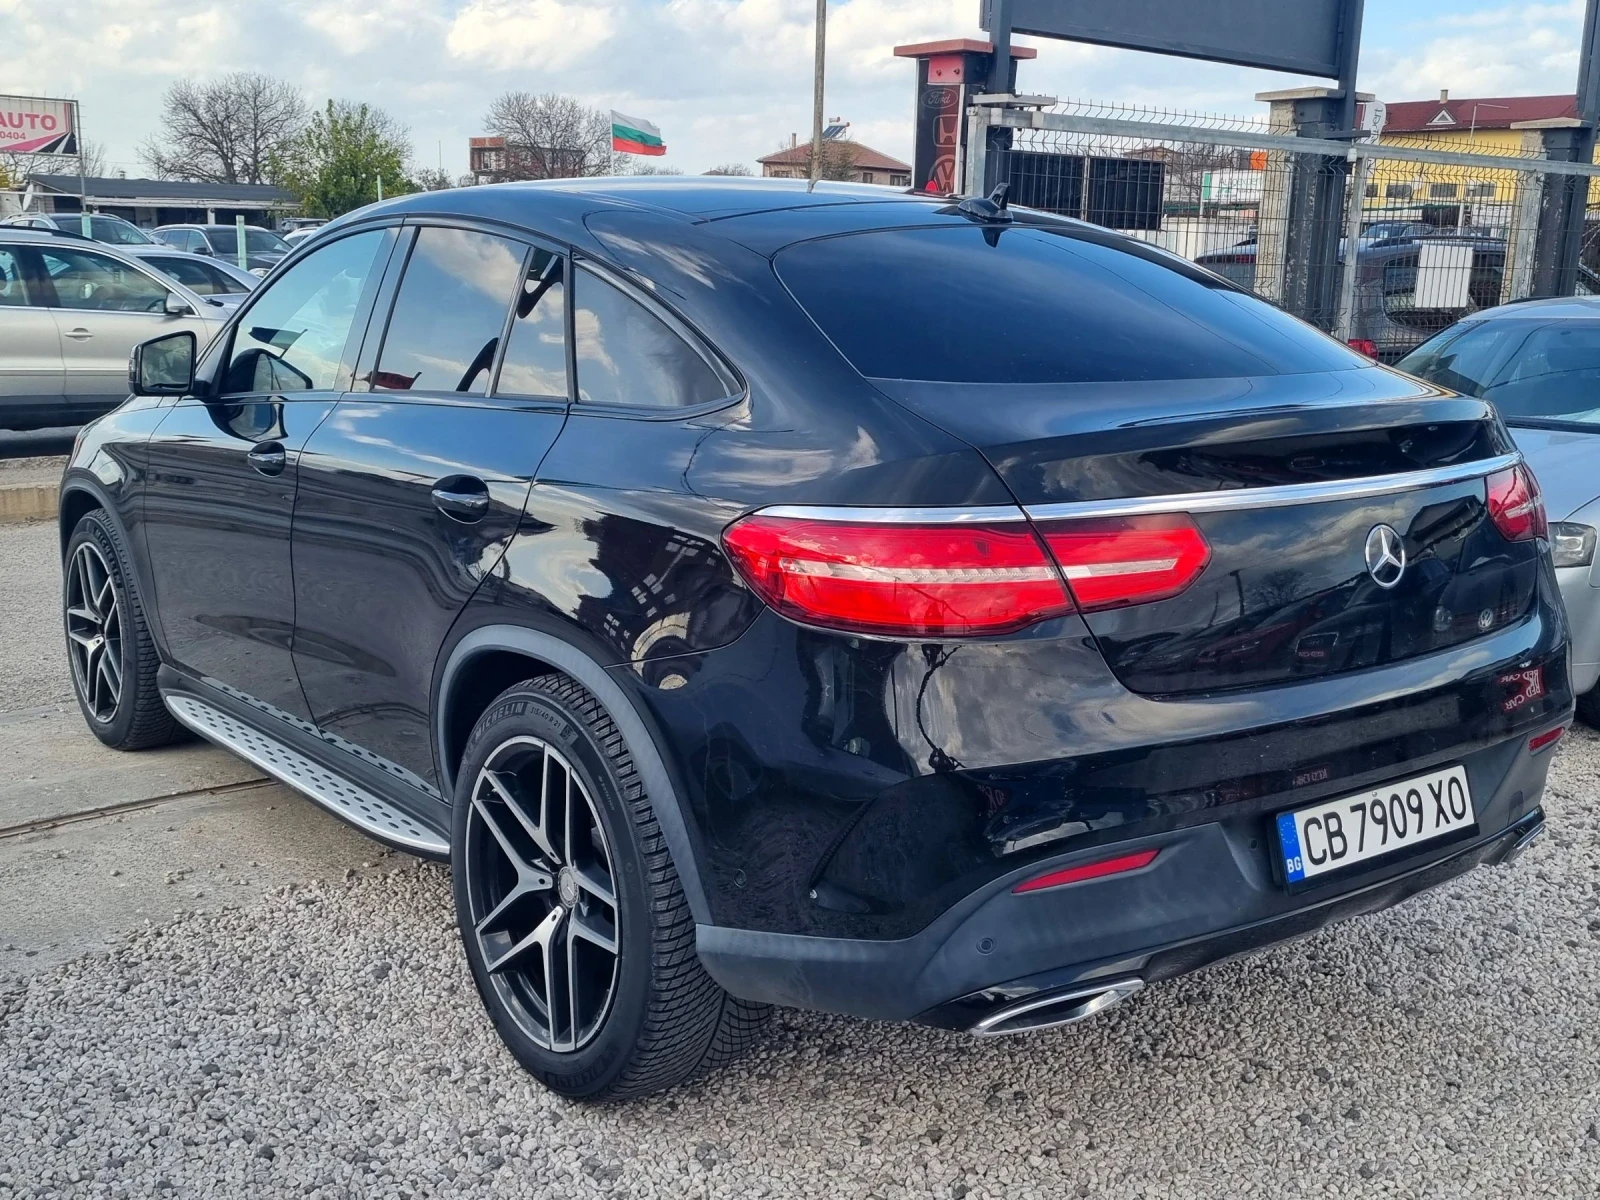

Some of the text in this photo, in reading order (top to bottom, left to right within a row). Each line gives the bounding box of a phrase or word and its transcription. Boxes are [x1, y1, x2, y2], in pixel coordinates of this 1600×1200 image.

[927, 91, 951, 105] Ford
[475, 702, 524, 741] MICHELIN
[1303, 776, 1467, 866] CB 7909 XO
[1286, 856, 1302, 874] BG
